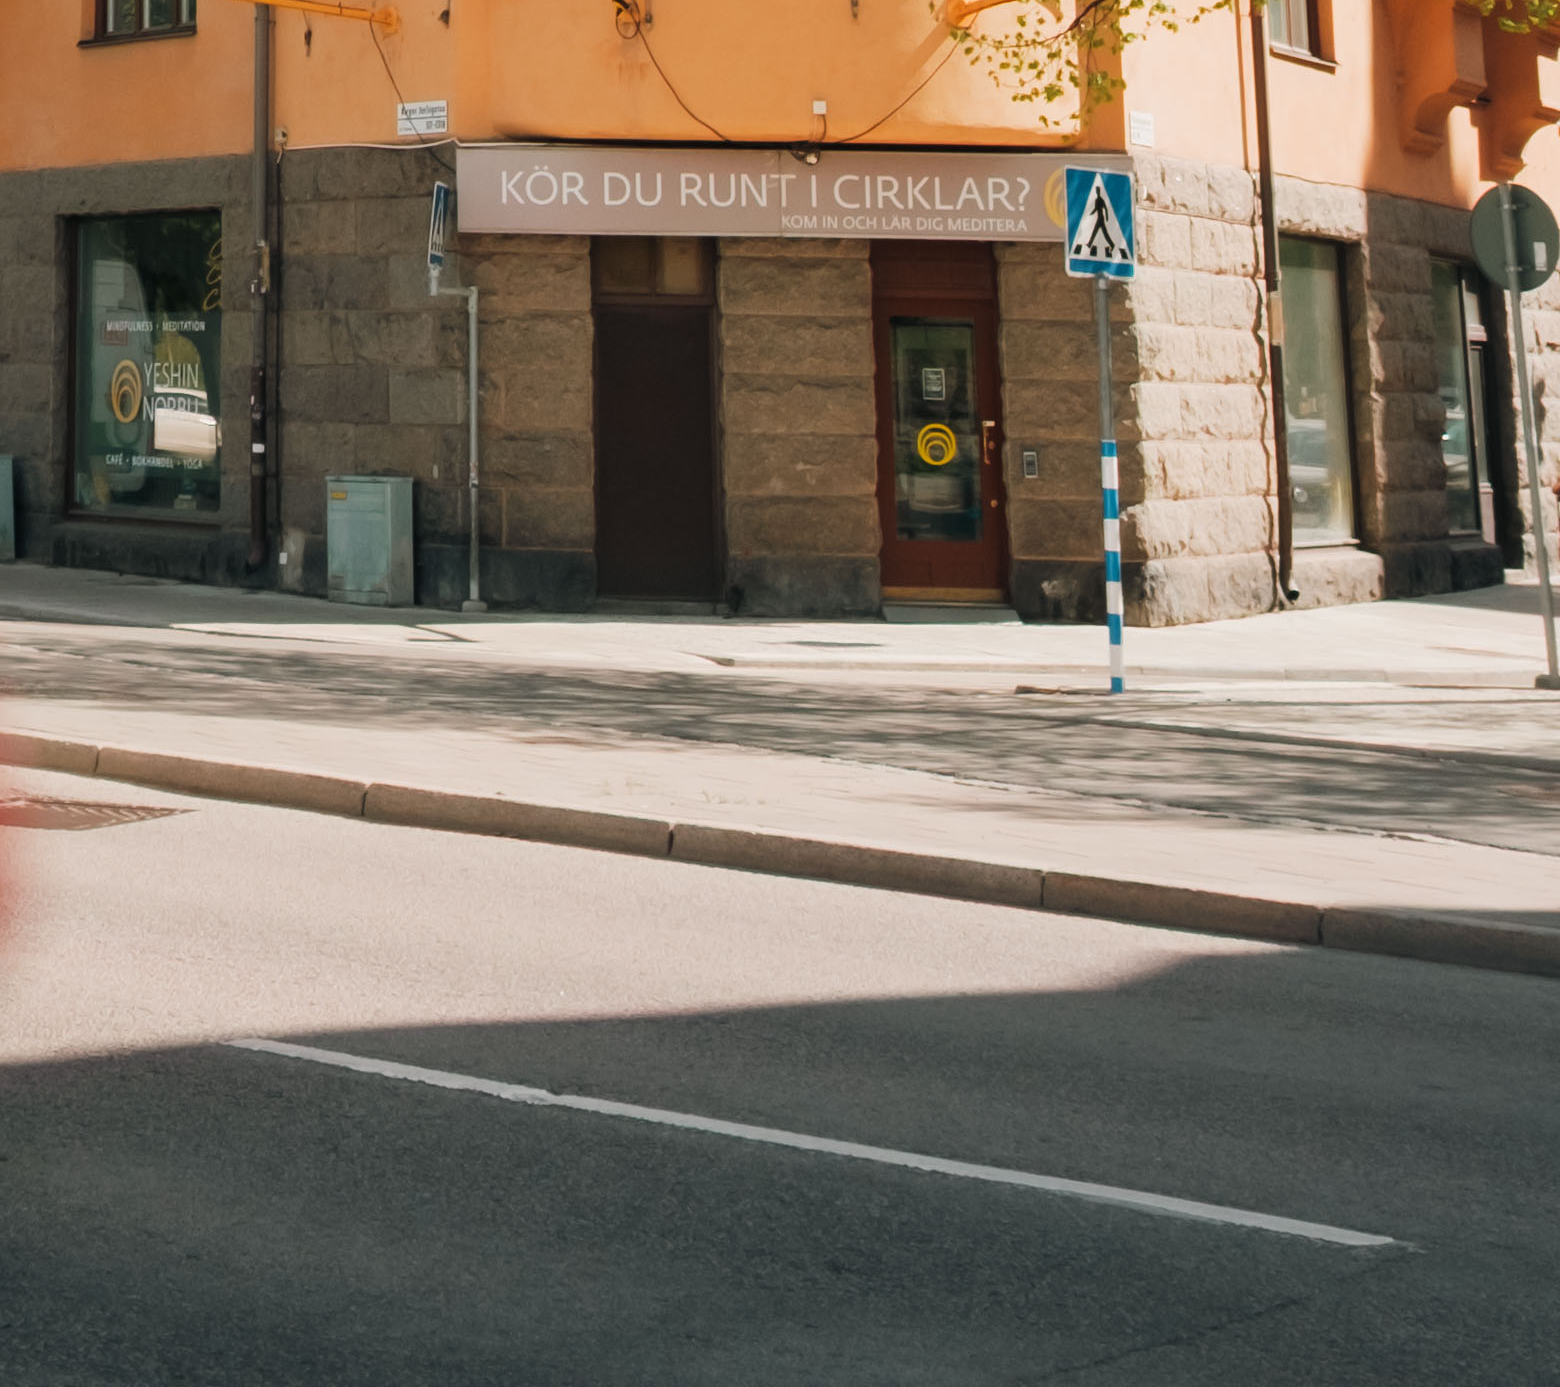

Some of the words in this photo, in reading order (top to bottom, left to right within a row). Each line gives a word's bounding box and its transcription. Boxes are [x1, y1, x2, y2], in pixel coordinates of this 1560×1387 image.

[501, 165, 589, 205] KÖR
[603, 172, 662, 206] DU
[680, 173, 797, 208] RUNT
[810, 175, 818, 207] I
[833, 174, 1031, 212] CIRKLAR?
[782, 215, 817, 228] KOM
[823, 215, 838, 229] IN
[842, 215, 877, 230] OCH
[882, 214, 911, 231] LÄR
[916, 217, 944, 231] DIG
[948, 217, 1028, 232] MEDITERA
[106, 320, 153, 332] MINDFULNESS
[162, 321, 206, 332] MEDITATION
[144, 362, 199, 388] YESHIN
[105, 453, 123, 465] CAFÉ
[132, 456, 174, 469] BOKHANDEL
[184, 459, 203, 470] YOGA
